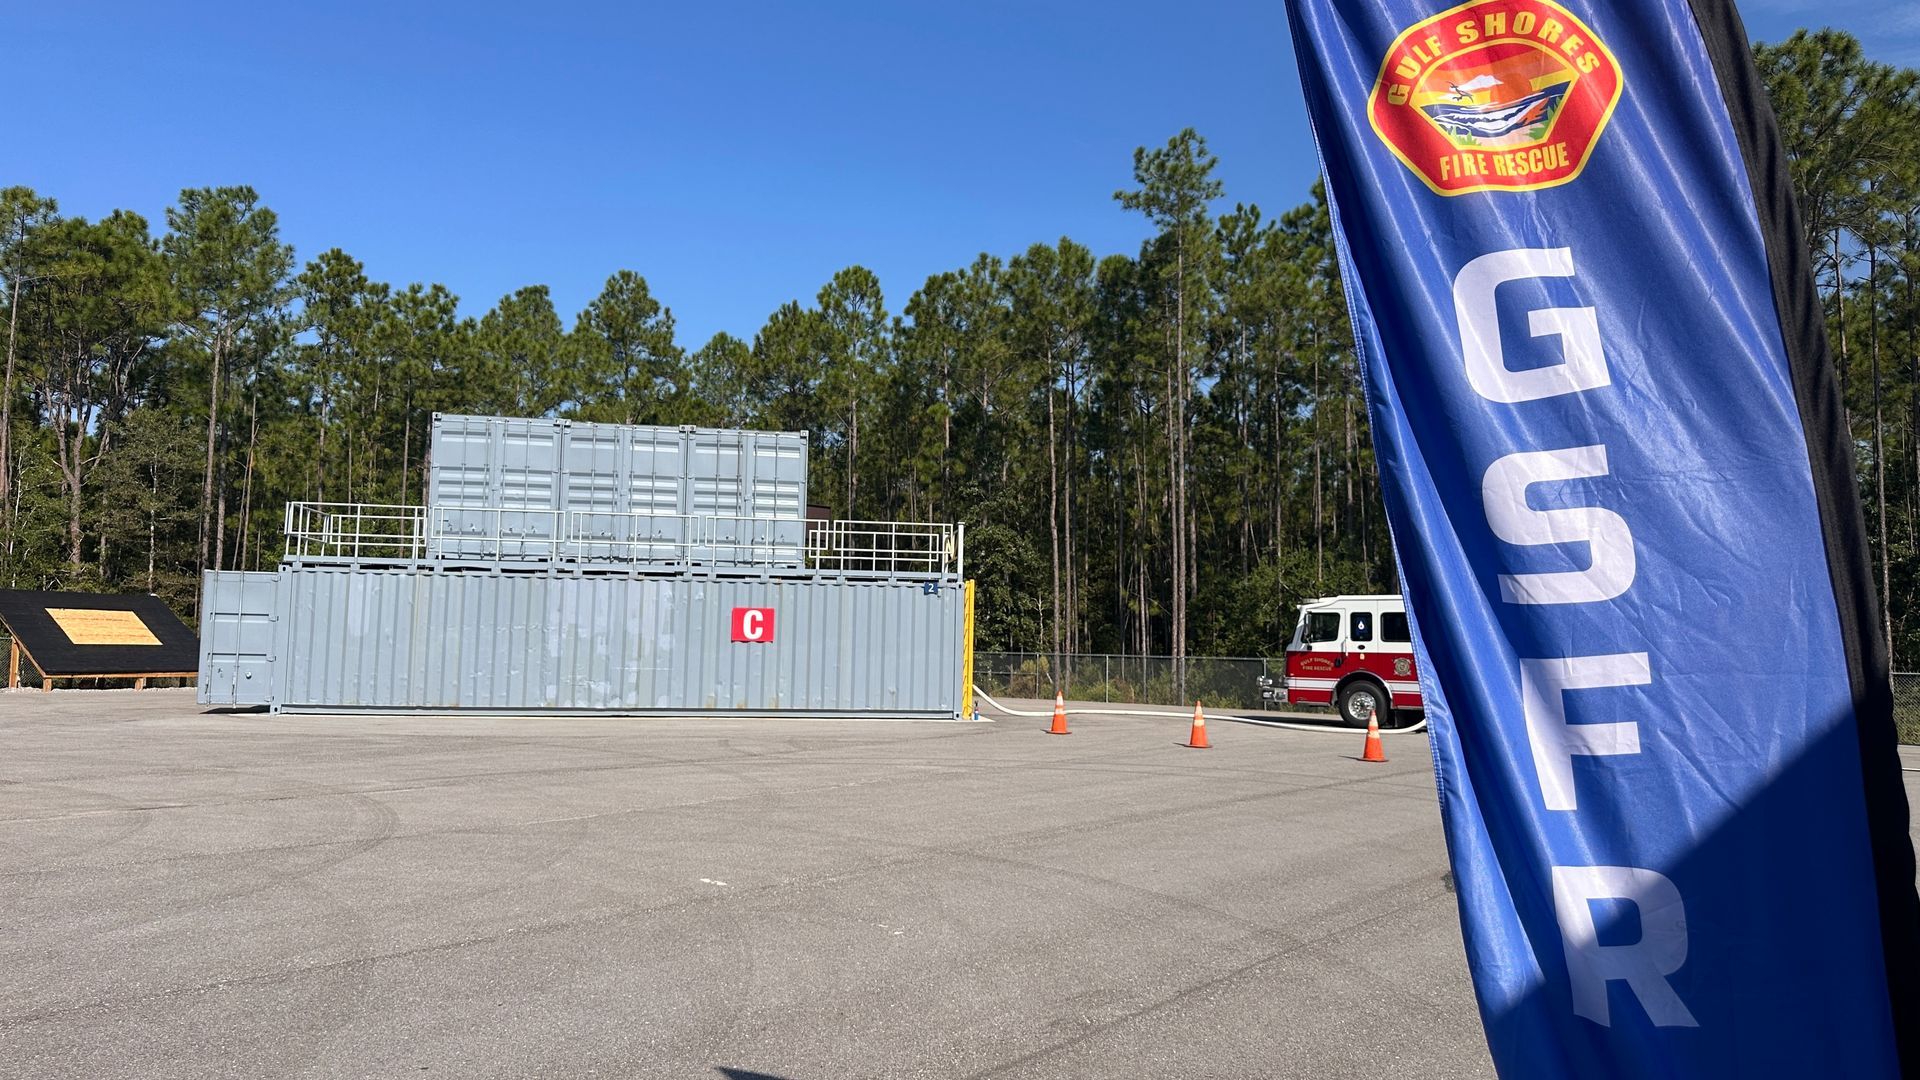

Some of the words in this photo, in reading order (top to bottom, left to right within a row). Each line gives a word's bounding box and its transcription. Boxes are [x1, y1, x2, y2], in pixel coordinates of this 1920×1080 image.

[1387, 35, 1443, 105] GULF
[1455, 11, 1601, 74] SHORES
[1440, 153, 1489, 180] FIRE
[1492, 142, 1570, 177] RESCUE
[928, 583, 935, 593] 2
[742, 609, 764, 640] C
[1452, 247, 1700, 1028] GSFR
